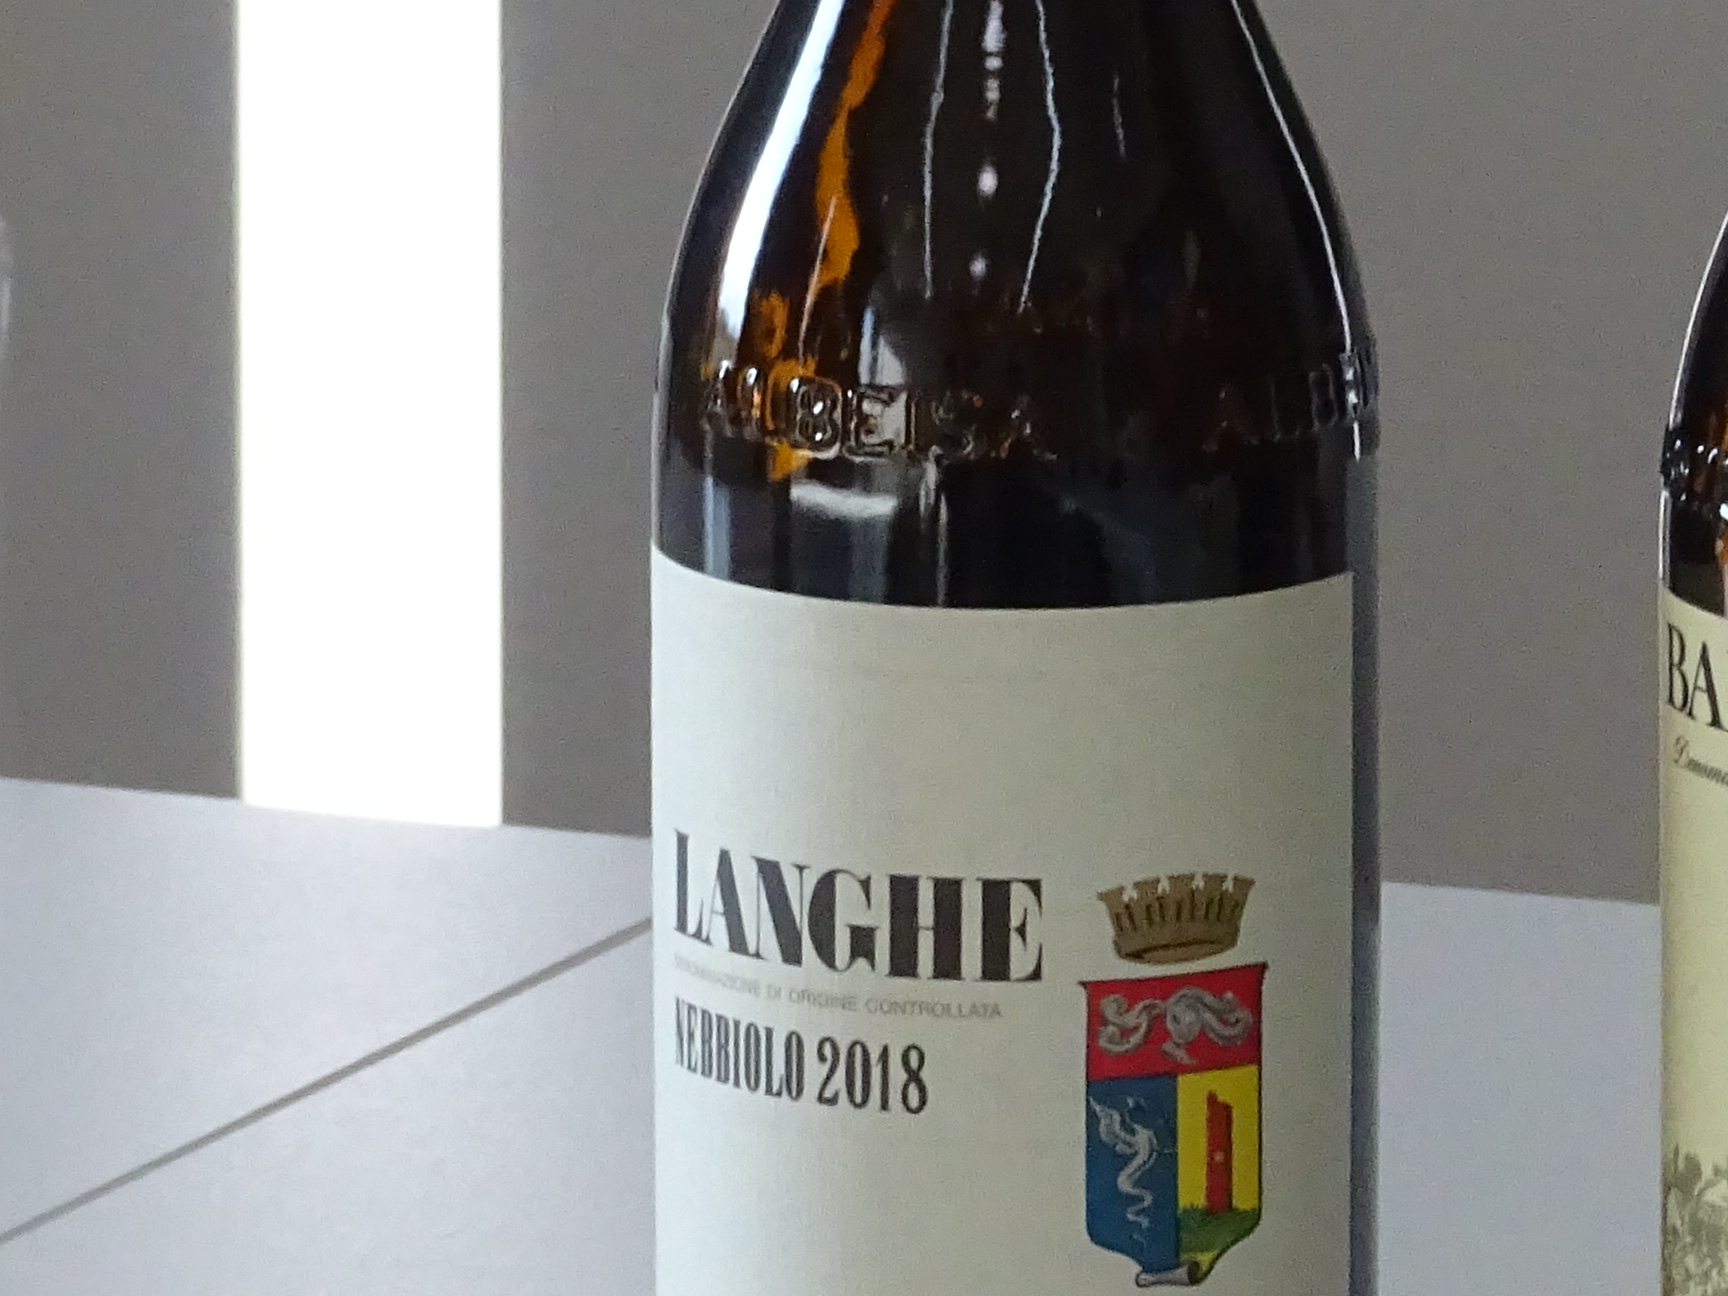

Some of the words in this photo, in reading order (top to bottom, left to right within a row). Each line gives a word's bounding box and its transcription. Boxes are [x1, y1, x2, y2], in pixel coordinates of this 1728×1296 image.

[675, 827, 1044, 983] LANGHE
[675, 995, 806, 1102] NEBBIOLO
[816, 1036, 930, 1115] 2018
